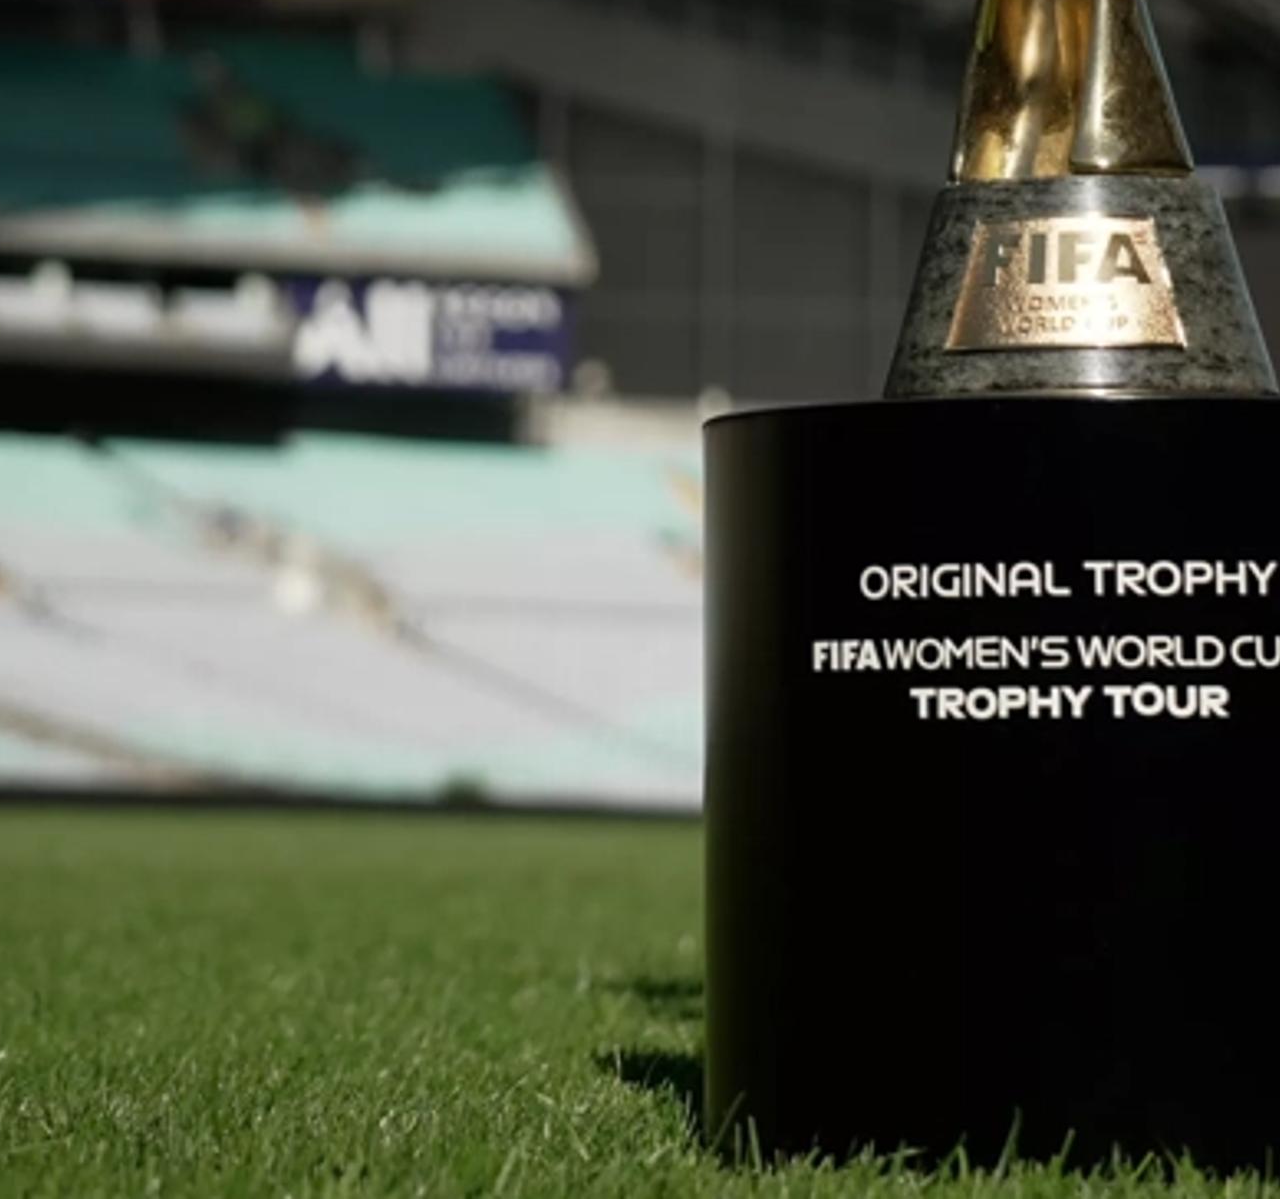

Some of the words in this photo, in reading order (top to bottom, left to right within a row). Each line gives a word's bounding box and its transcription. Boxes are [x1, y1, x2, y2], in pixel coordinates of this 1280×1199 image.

[979, 231, 1152, 285] FIFA
[859, 561, 1072, 600] ORIGINAL
[1082, 559, 1278, 597] TROPHY
[812, 638, 882, 672] FIFA
[882, 635, 1071, 671] WOMEN'S
[1076, 634, 1226, 669] WORLD
[909, 685, 1093, 720] TROPHY
[1102, 682, 1230, 719] TOUR
